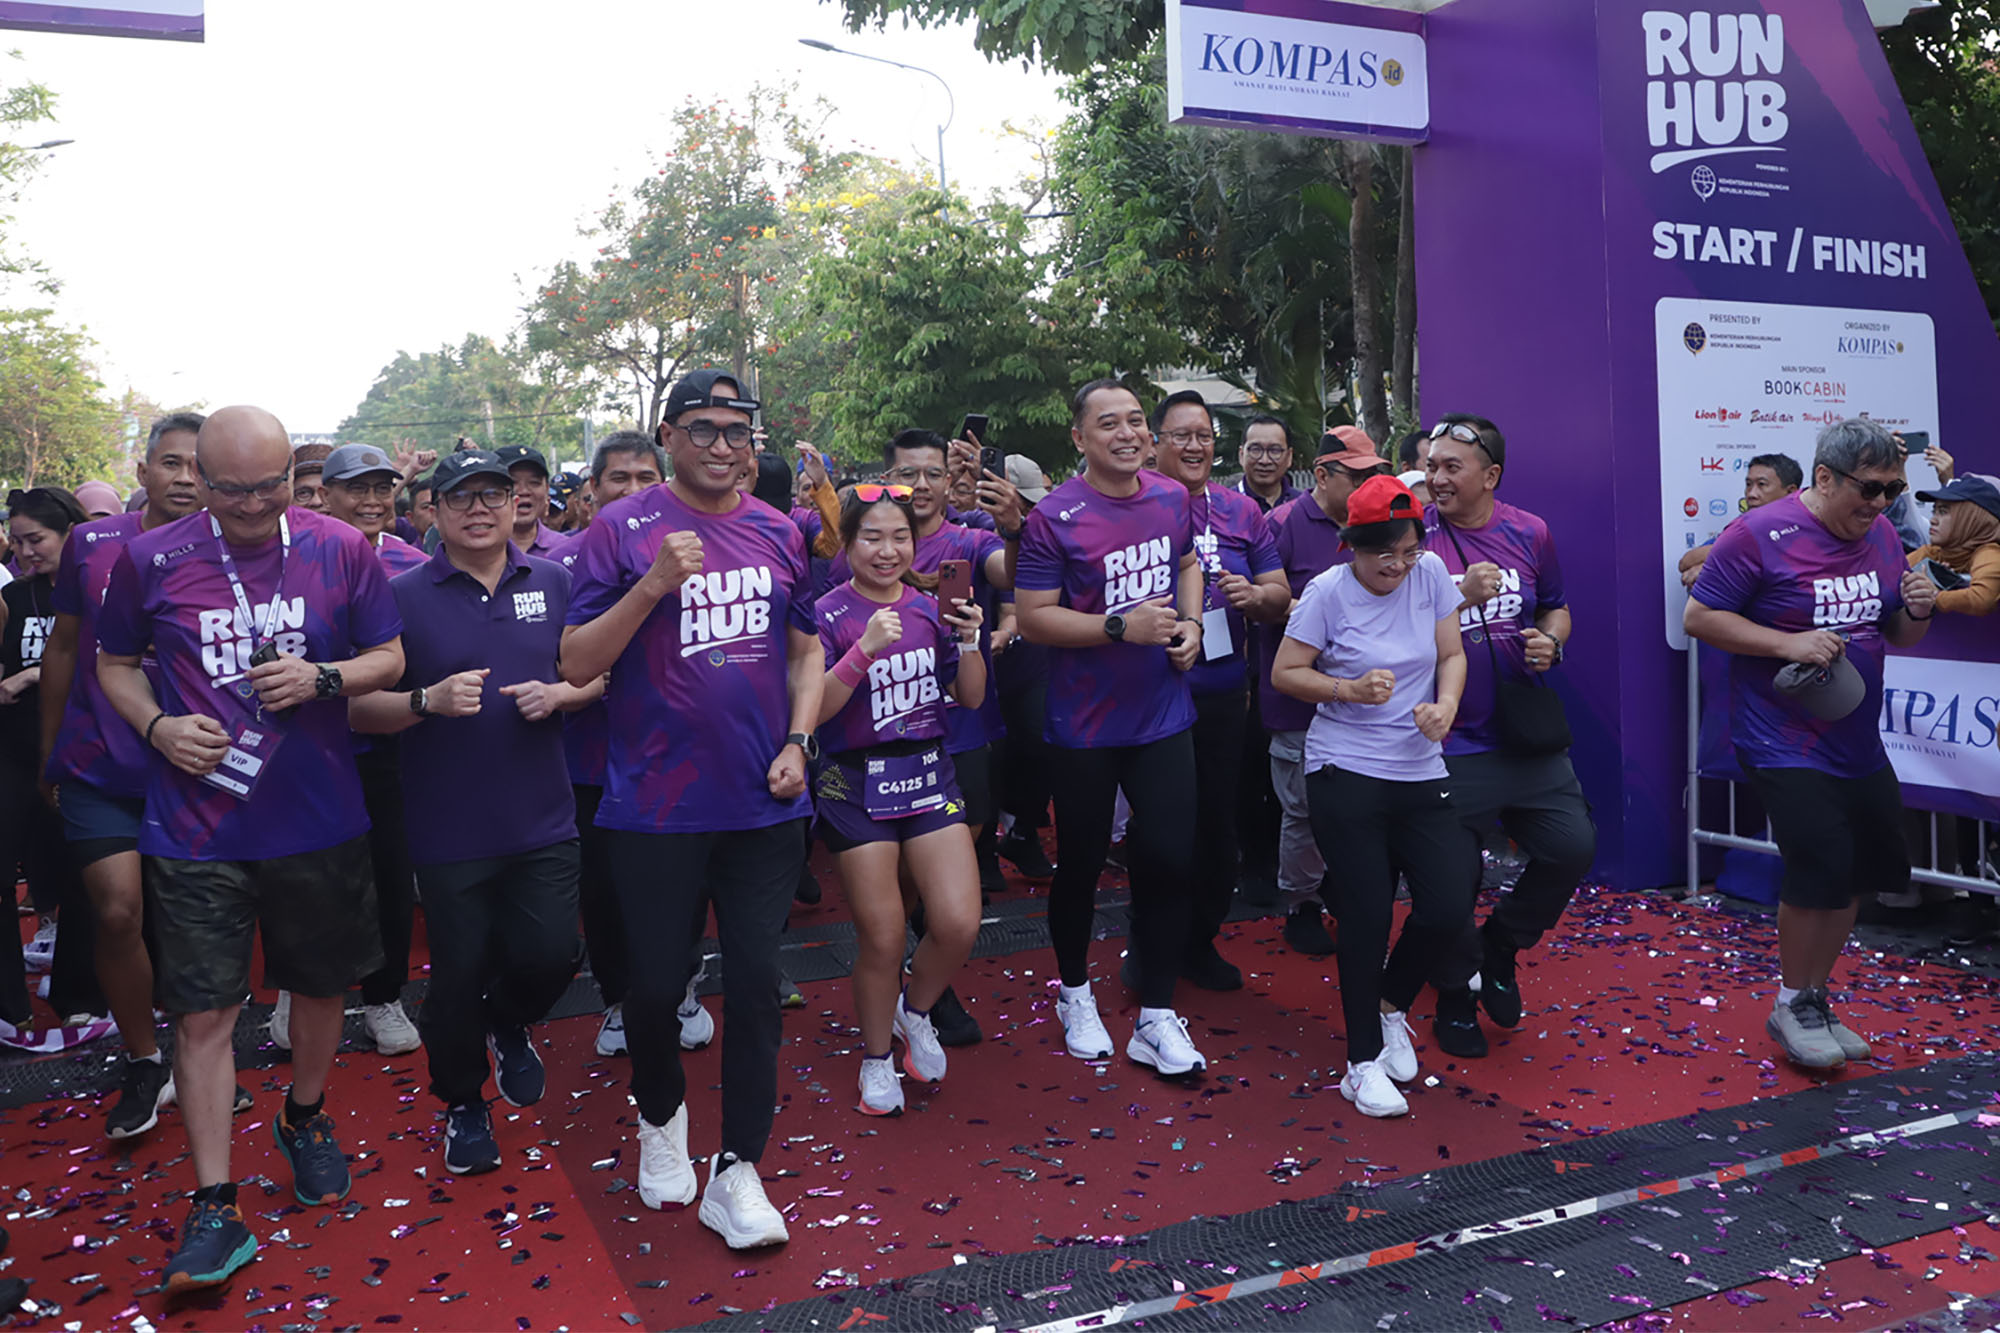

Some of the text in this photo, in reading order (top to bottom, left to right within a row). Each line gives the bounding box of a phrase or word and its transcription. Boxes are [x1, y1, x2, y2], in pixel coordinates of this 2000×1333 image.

[1642, 11, 1784, 77] RUN
[1198, 33, 1378, 89] KOMPAS
[1647, 79, 1789, 147] HUB
[1652, 221, 1778, 267] START
[1812, 235, 1927, 279] FINISH
[1709, 313, 1761, 325] PRESENTED BY
[1838, 336, 1896, 355] KOMPAS
[1781, 365, 1826, 374] MAIN SPONSOR
[1695, 409, 1742, 419] Lion air
[1750, 409, 1777, 423] Batik
[168, 543, 195, 559] MILLS
[1103, 535, 1171, 580] RUN
[512, 590, 545, 604] RUN
[680, 566, 772, 609] RUN
[1104, 564, 1172, 606] HUB
[1813, 570, 1880, 604] RUN
[198, 596, 305, 644] RUN
[515, 602, 547, 616] HUB
[680, 600, 771, 644] HUB
[1813, 598, 1883, 626] HUB
[867, 647, 936, 691] RUN
[871, 675, 940, 720] HUB
[231, 754, 248, 766] VIP
[922, 750, 939, 766] 10K
[878, 776, 923, 795] C4125
